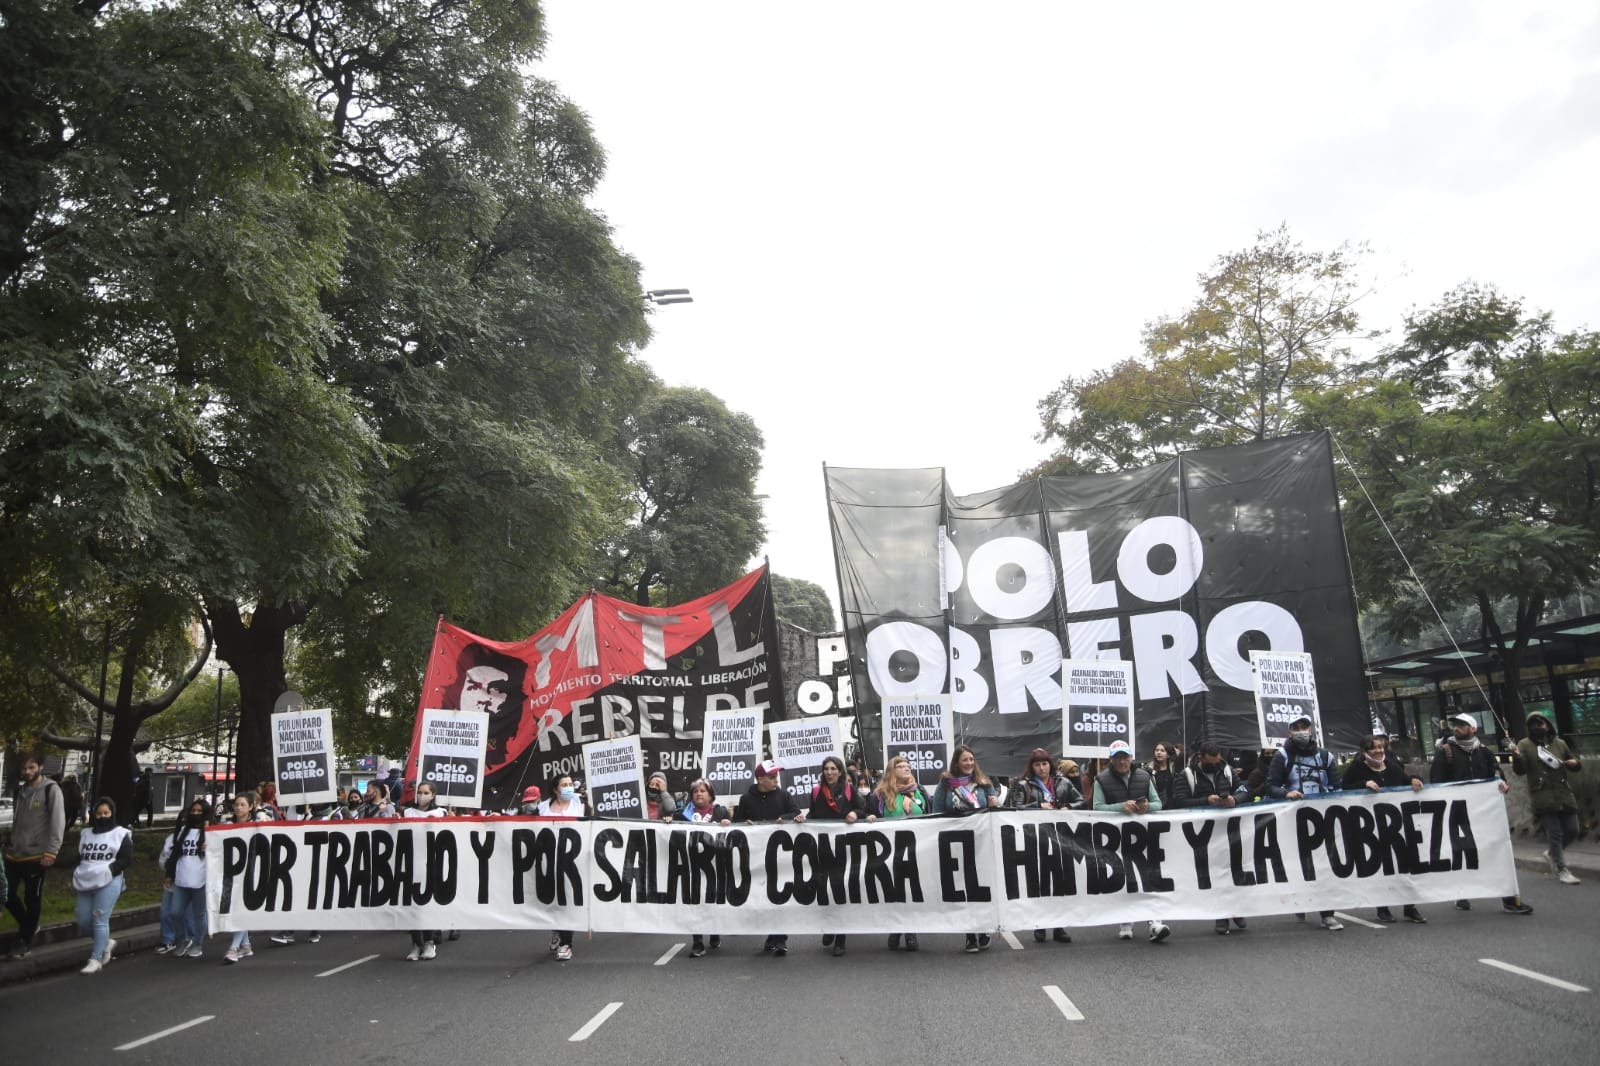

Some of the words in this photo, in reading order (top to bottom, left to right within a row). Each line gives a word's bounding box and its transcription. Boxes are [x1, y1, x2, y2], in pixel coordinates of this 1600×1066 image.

[534, 598, 764, 690] MTL
[1259, 659, 1272, 669] POR
[1274, 660, 1283, 670] UN
[1285, 661, 1304, 672] PARO
[1261, 671, 1298, 683] NACIONAL
[1300, 673, 1305, 684] Y
[530, 673, 602, 710] MOMIENTO
[609, 672, 693, 688] TERRITORIAL
[701, 661, 767, 686] LIBERACIÓN
[1262, 683, 1279, 695] PLAN
[1280, 684, 1287, 695] DE
[1288, 685, 1308, 696] LUCHA
[890, 705, 904, 717] POR
[906, 705, 916, 716] UN
[919, 704, 941, 715] PARO
[1272, 703, 1302, 714] POLO
[278, 719, 290, 730] POR
[292, 718, 300, 730] UN
[302, 717, 321, 728] PARO
[712, 719, 724, 730] POR
[725, 718, 735, 729] UN
[736, 717, 755, 728] PARO
[891, 716, 935, 729] NACIONAL
[936, 716, 941, 727] Y
[1083, 713, 1117, 723] POLO
[1074, 722, 1127, 733] OBRERO
[279, 729, 316, 742] NACIONAL
[317, 728, 321, 739] Y
[712, 729, 748, 742] NACIONAL
[750, 729, 755, 739] Y
[891, 730, 909, 742] PLAN
[911, 729, 918, 741] DE
[920, 729, 943, 741] LUCHA
[280, 742, 295, 753] PLAN
[296, 742, 302, 752] DE
[304, 740, 323, 752] LUCHA
[711, 742, 726, 753] PLAN
[728, 742, 734, 752] DE
[735, 741, 753, 752] LUCHA
[287, 760, 316, 771] POLO
[660, 751, 703, 771] BUEN
[716, 761, 745, 771] POLO
[909, 760, 943, 770] RERO
[281, 768, 324, 780] OBRERO
[435, 763, 467, 773] POLO
[426, 771, 475, 783] OBRERO
[709, 770, 752, 780] OBRERO
[603, 789, 631, 801] POLO
[786, 783, 815, 796] OBR
[597, 797, 639, 812] OBRERO
[183, 839, 199, 847] OL
[81, 852, 113, 861] RERO
[219, 833, 298, 914] POR
[304, 829, 457, 910] TRABAJO
[470, 831, 496, 904] Y
[512, 827, 584, 907] POR
[593, 828, 752, 906] SALARIO
[765, 829, 924, 906] CONTRA
[938, 830, 991, 902] EL
[1000, 820, 1174, 900] HAMBRE
[1182, 819, 1214, 890] Y
[1227, 813, 1288, 887] LA
[1296, 800, 1479, 881] POBREZA
